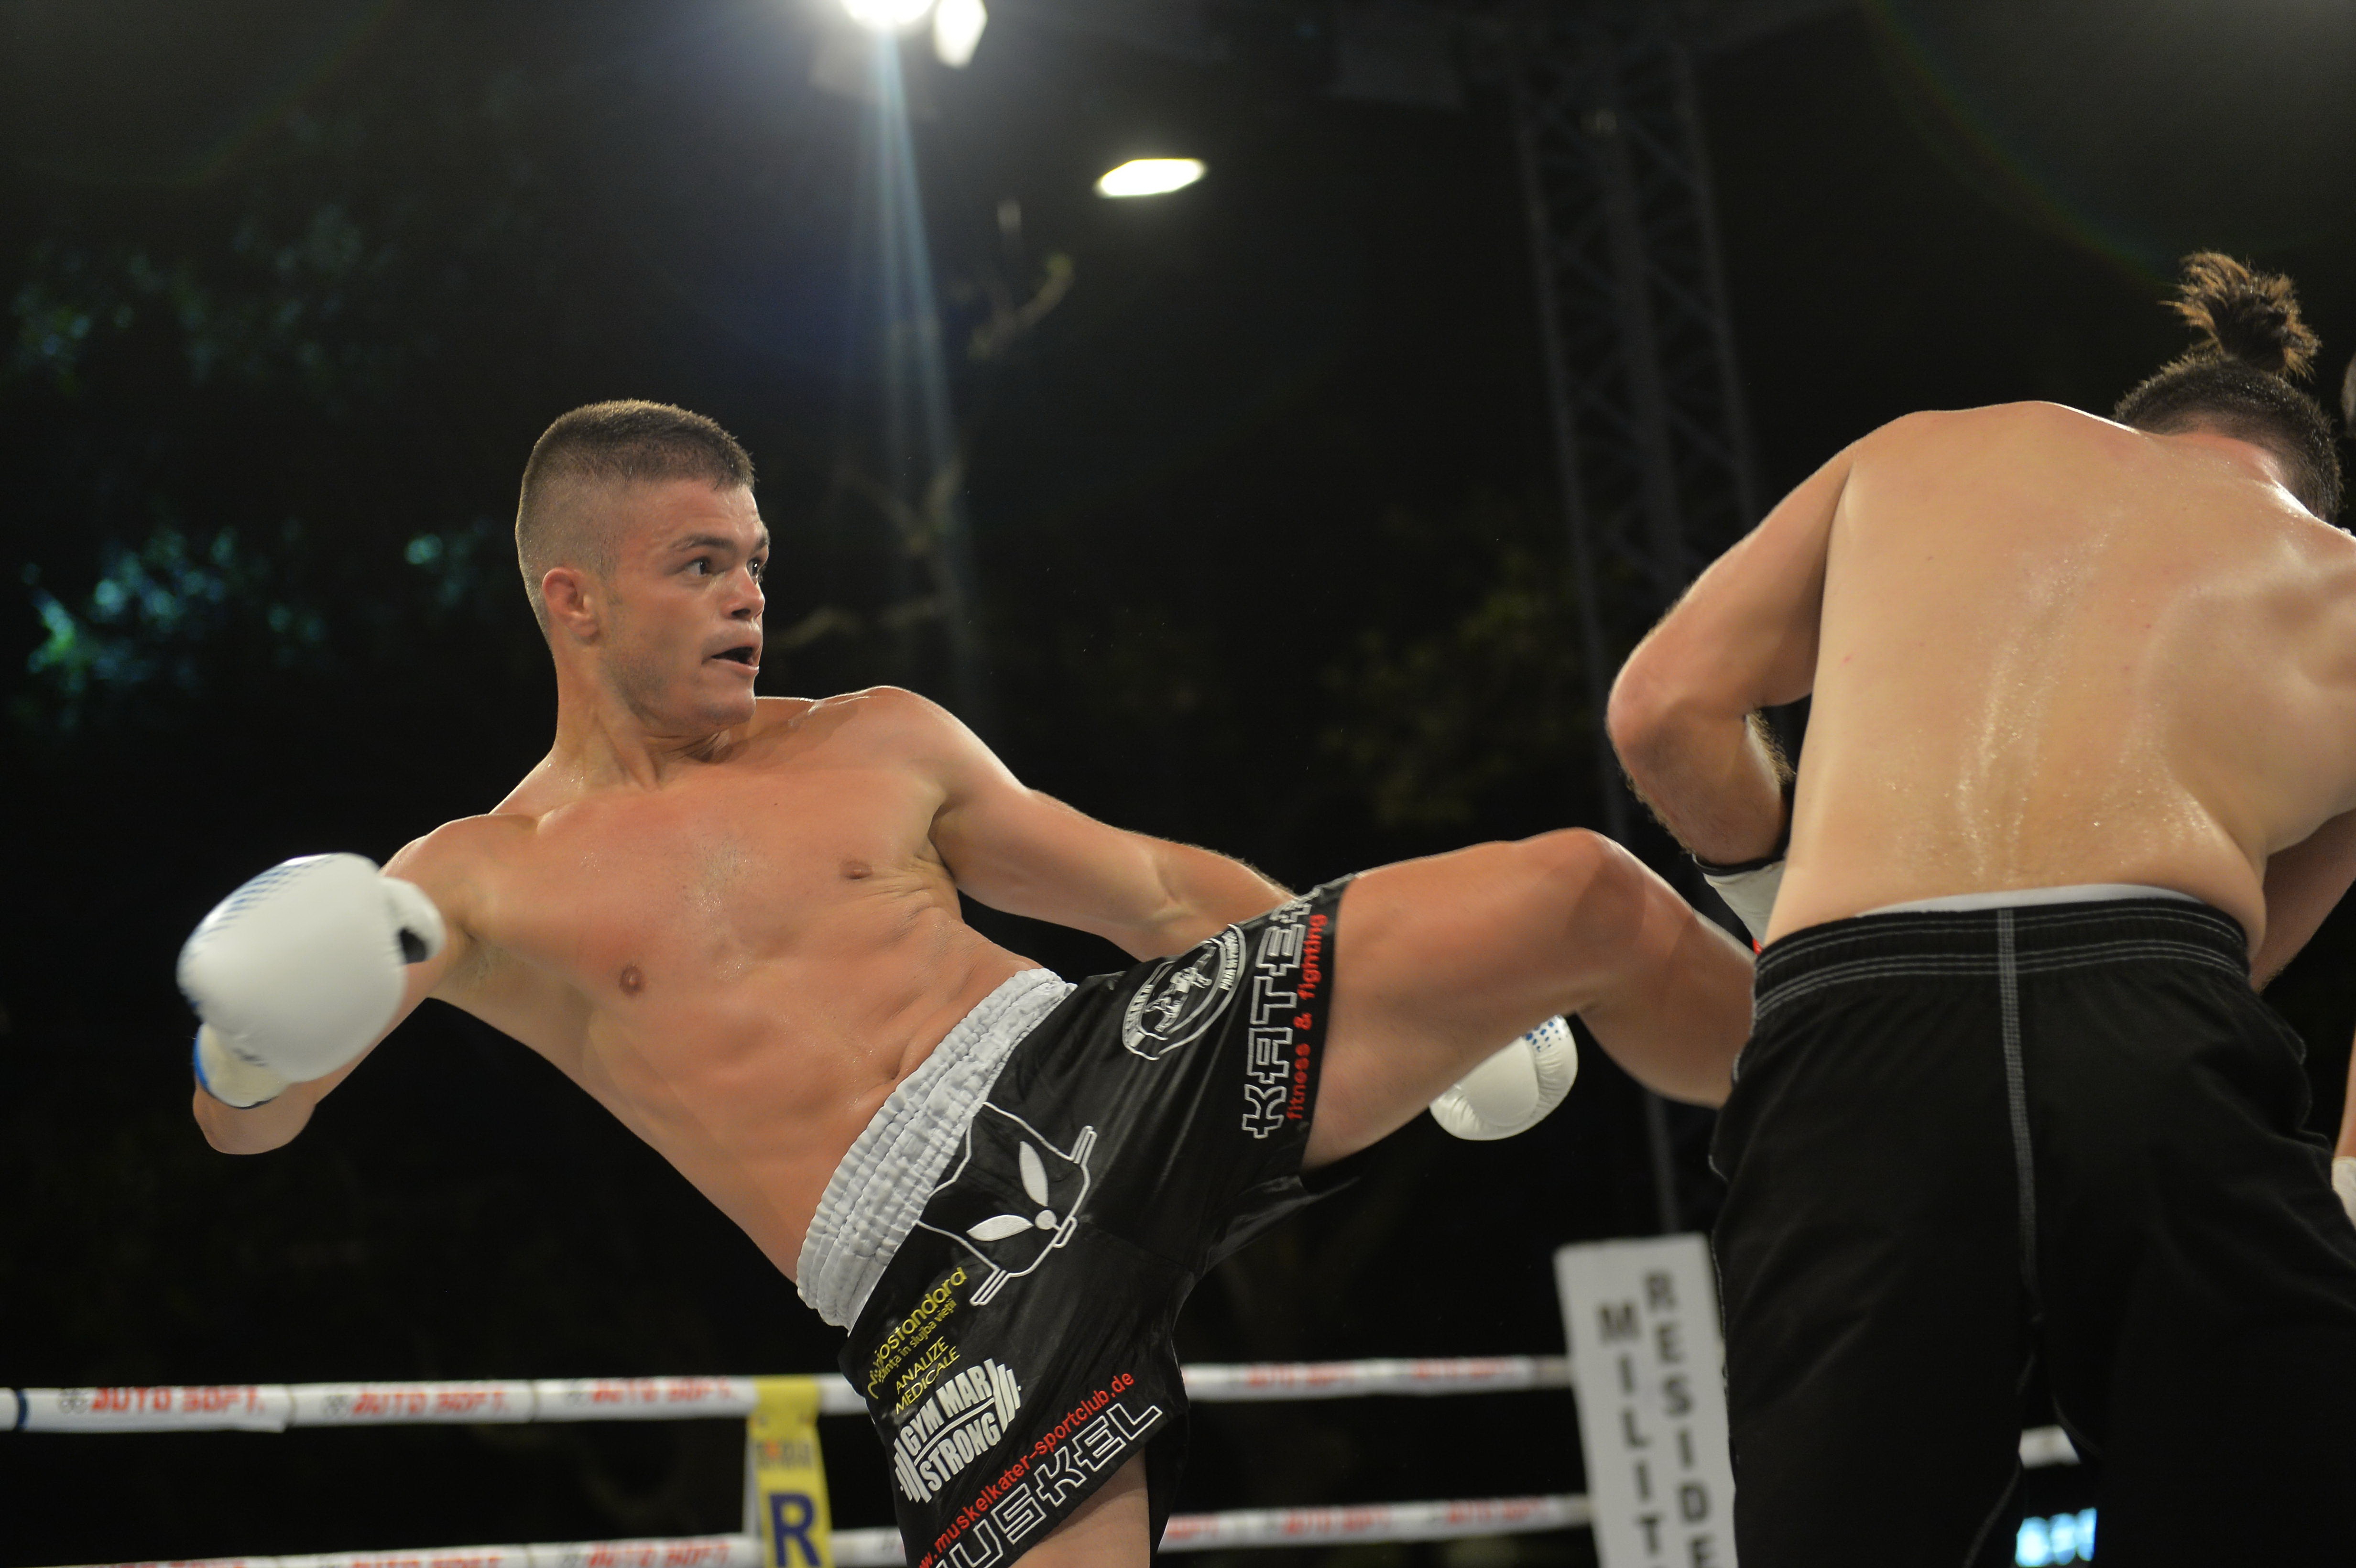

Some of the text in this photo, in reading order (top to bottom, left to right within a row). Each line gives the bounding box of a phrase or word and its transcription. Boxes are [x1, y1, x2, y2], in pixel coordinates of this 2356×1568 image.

[1286, 914, 1329, 1120] fitness & fighting
[895, 1336, 949, 1395] ANALIZE
[895, 1346, 960, 1416] MEDICALE
[900, 1365, 993, 1457] GYM MAR
[1645, 1272, 1721, 1568] RESIDE
[919, 1412, 1002, 1492] STRONG
[934, 1403, 1163, 1568] USKEL
[1598, 1302, 1664, 1568] MILIT
